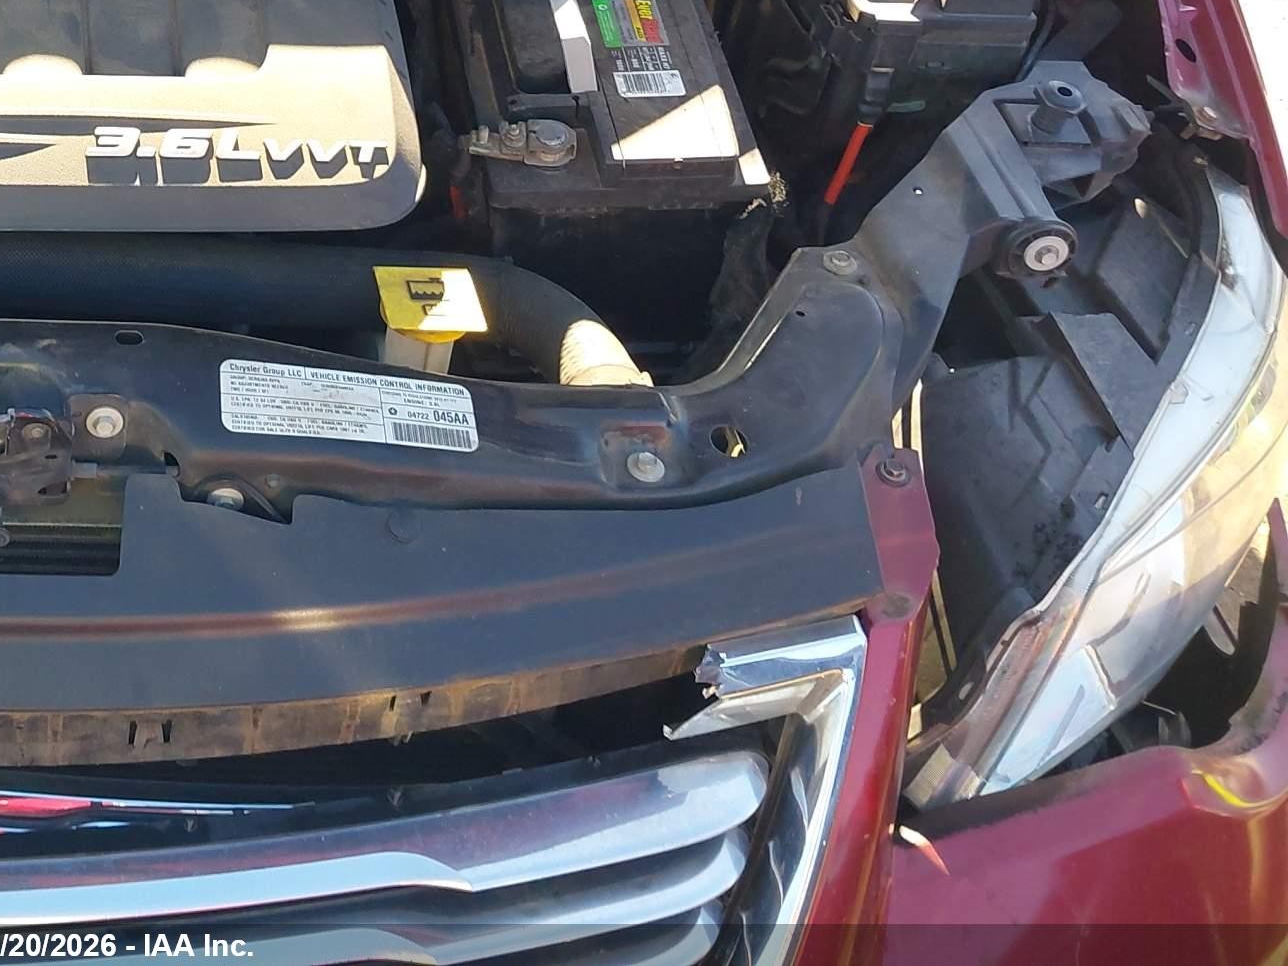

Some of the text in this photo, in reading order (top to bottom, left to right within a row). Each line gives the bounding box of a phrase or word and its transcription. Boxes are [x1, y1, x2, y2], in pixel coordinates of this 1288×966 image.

[85, 126, 388, 163] 3.6L VVT
[230, 363, 301, 377] Chrysler Group LLC
[310, 371, 464, 396] VEHICLE EMISSION CONTROL INFORMATION
[407, 410, 469, 425] 04722 045AA
